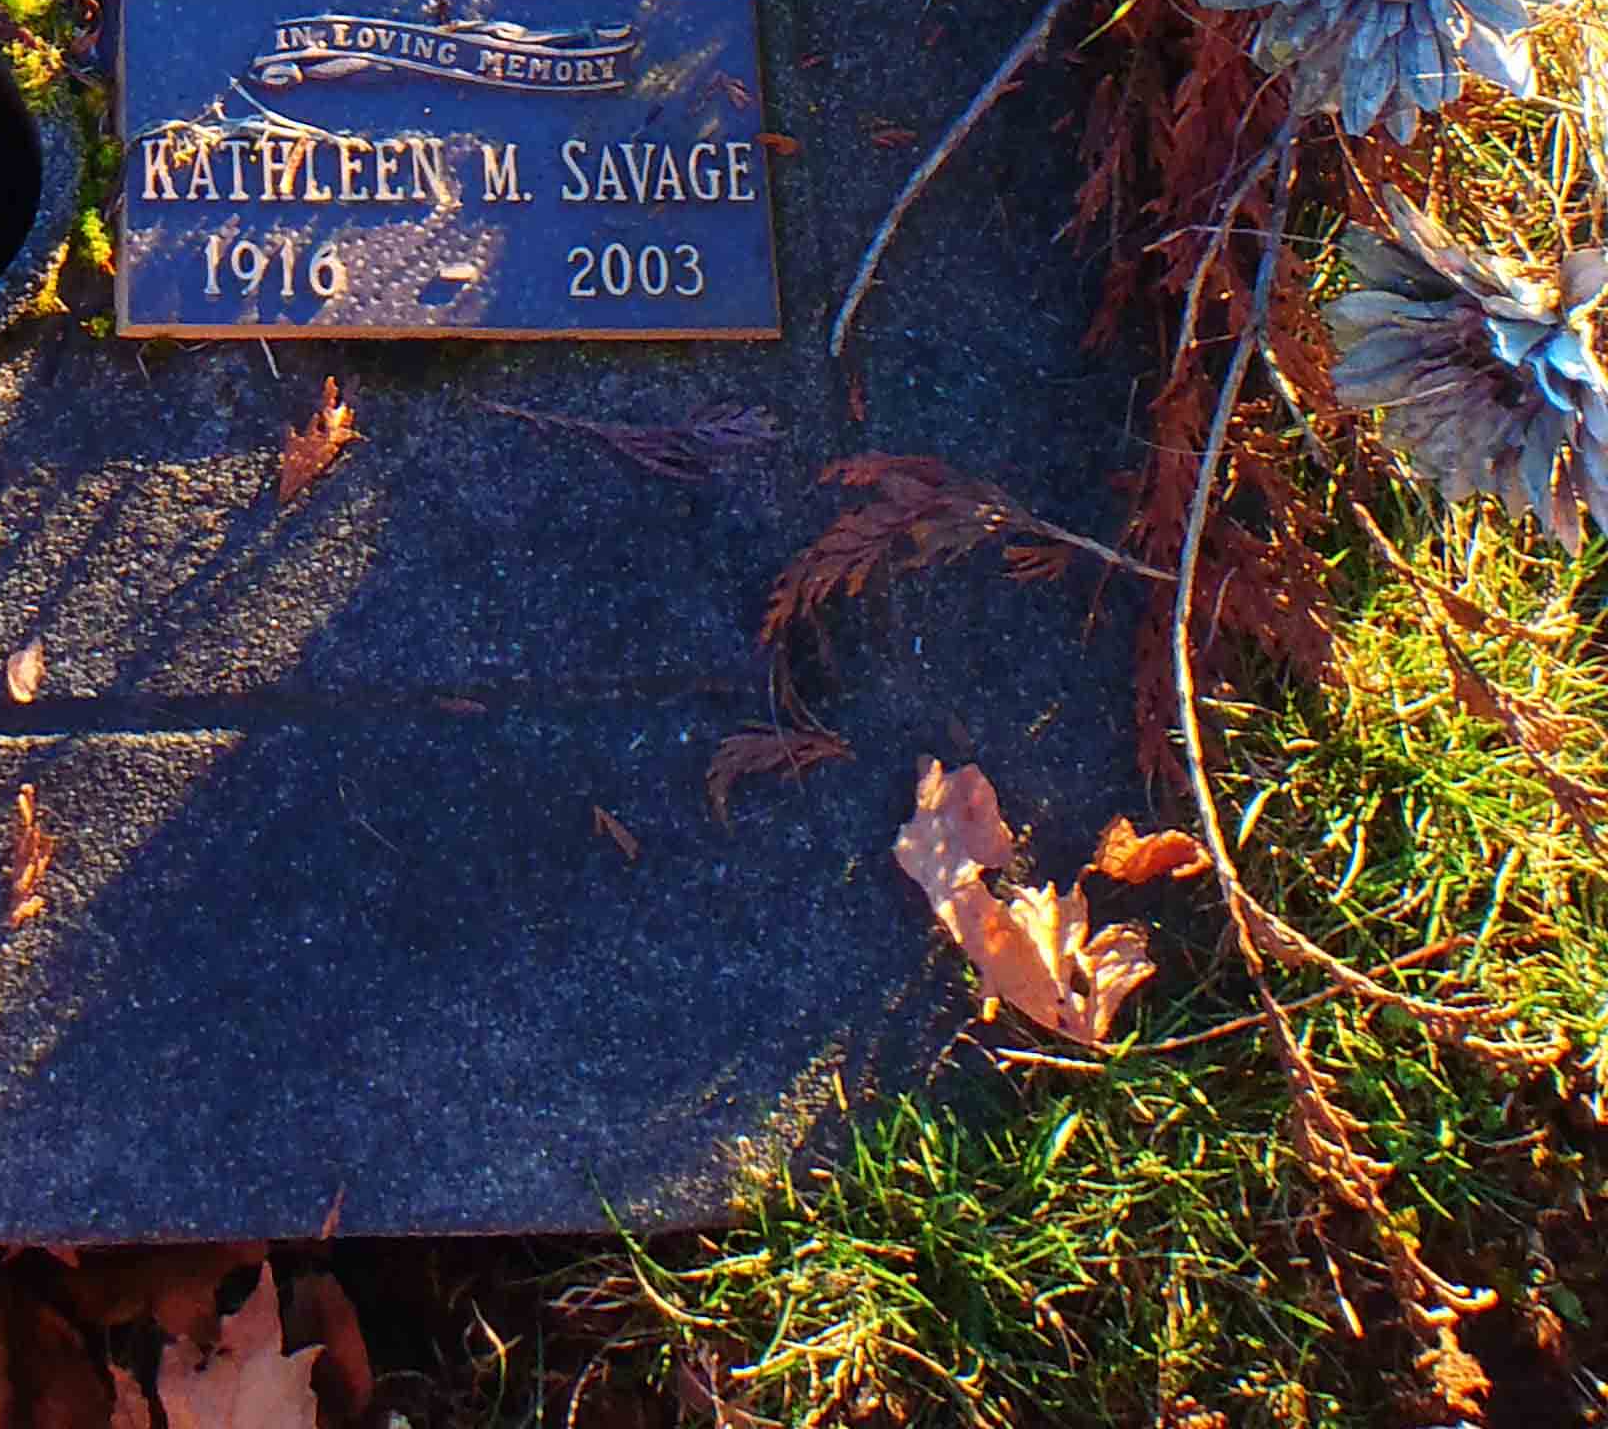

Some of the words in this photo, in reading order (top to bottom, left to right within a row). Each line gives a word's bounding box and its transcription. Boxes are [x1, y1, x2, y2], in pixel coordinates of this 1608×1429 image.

[276, 27, 319, 50] IN
[334, 24, 457, 63] LOVING
[479, 50, 616, 82] MEMORY
[142, 138, 444, 202] KATHLEEN
[482, 144, 532, 202] M.
[562, 142, 755, 202] SAVAGE
[202, 234, 341, 297] 1916
[569, 243, 704, 298] 2003
